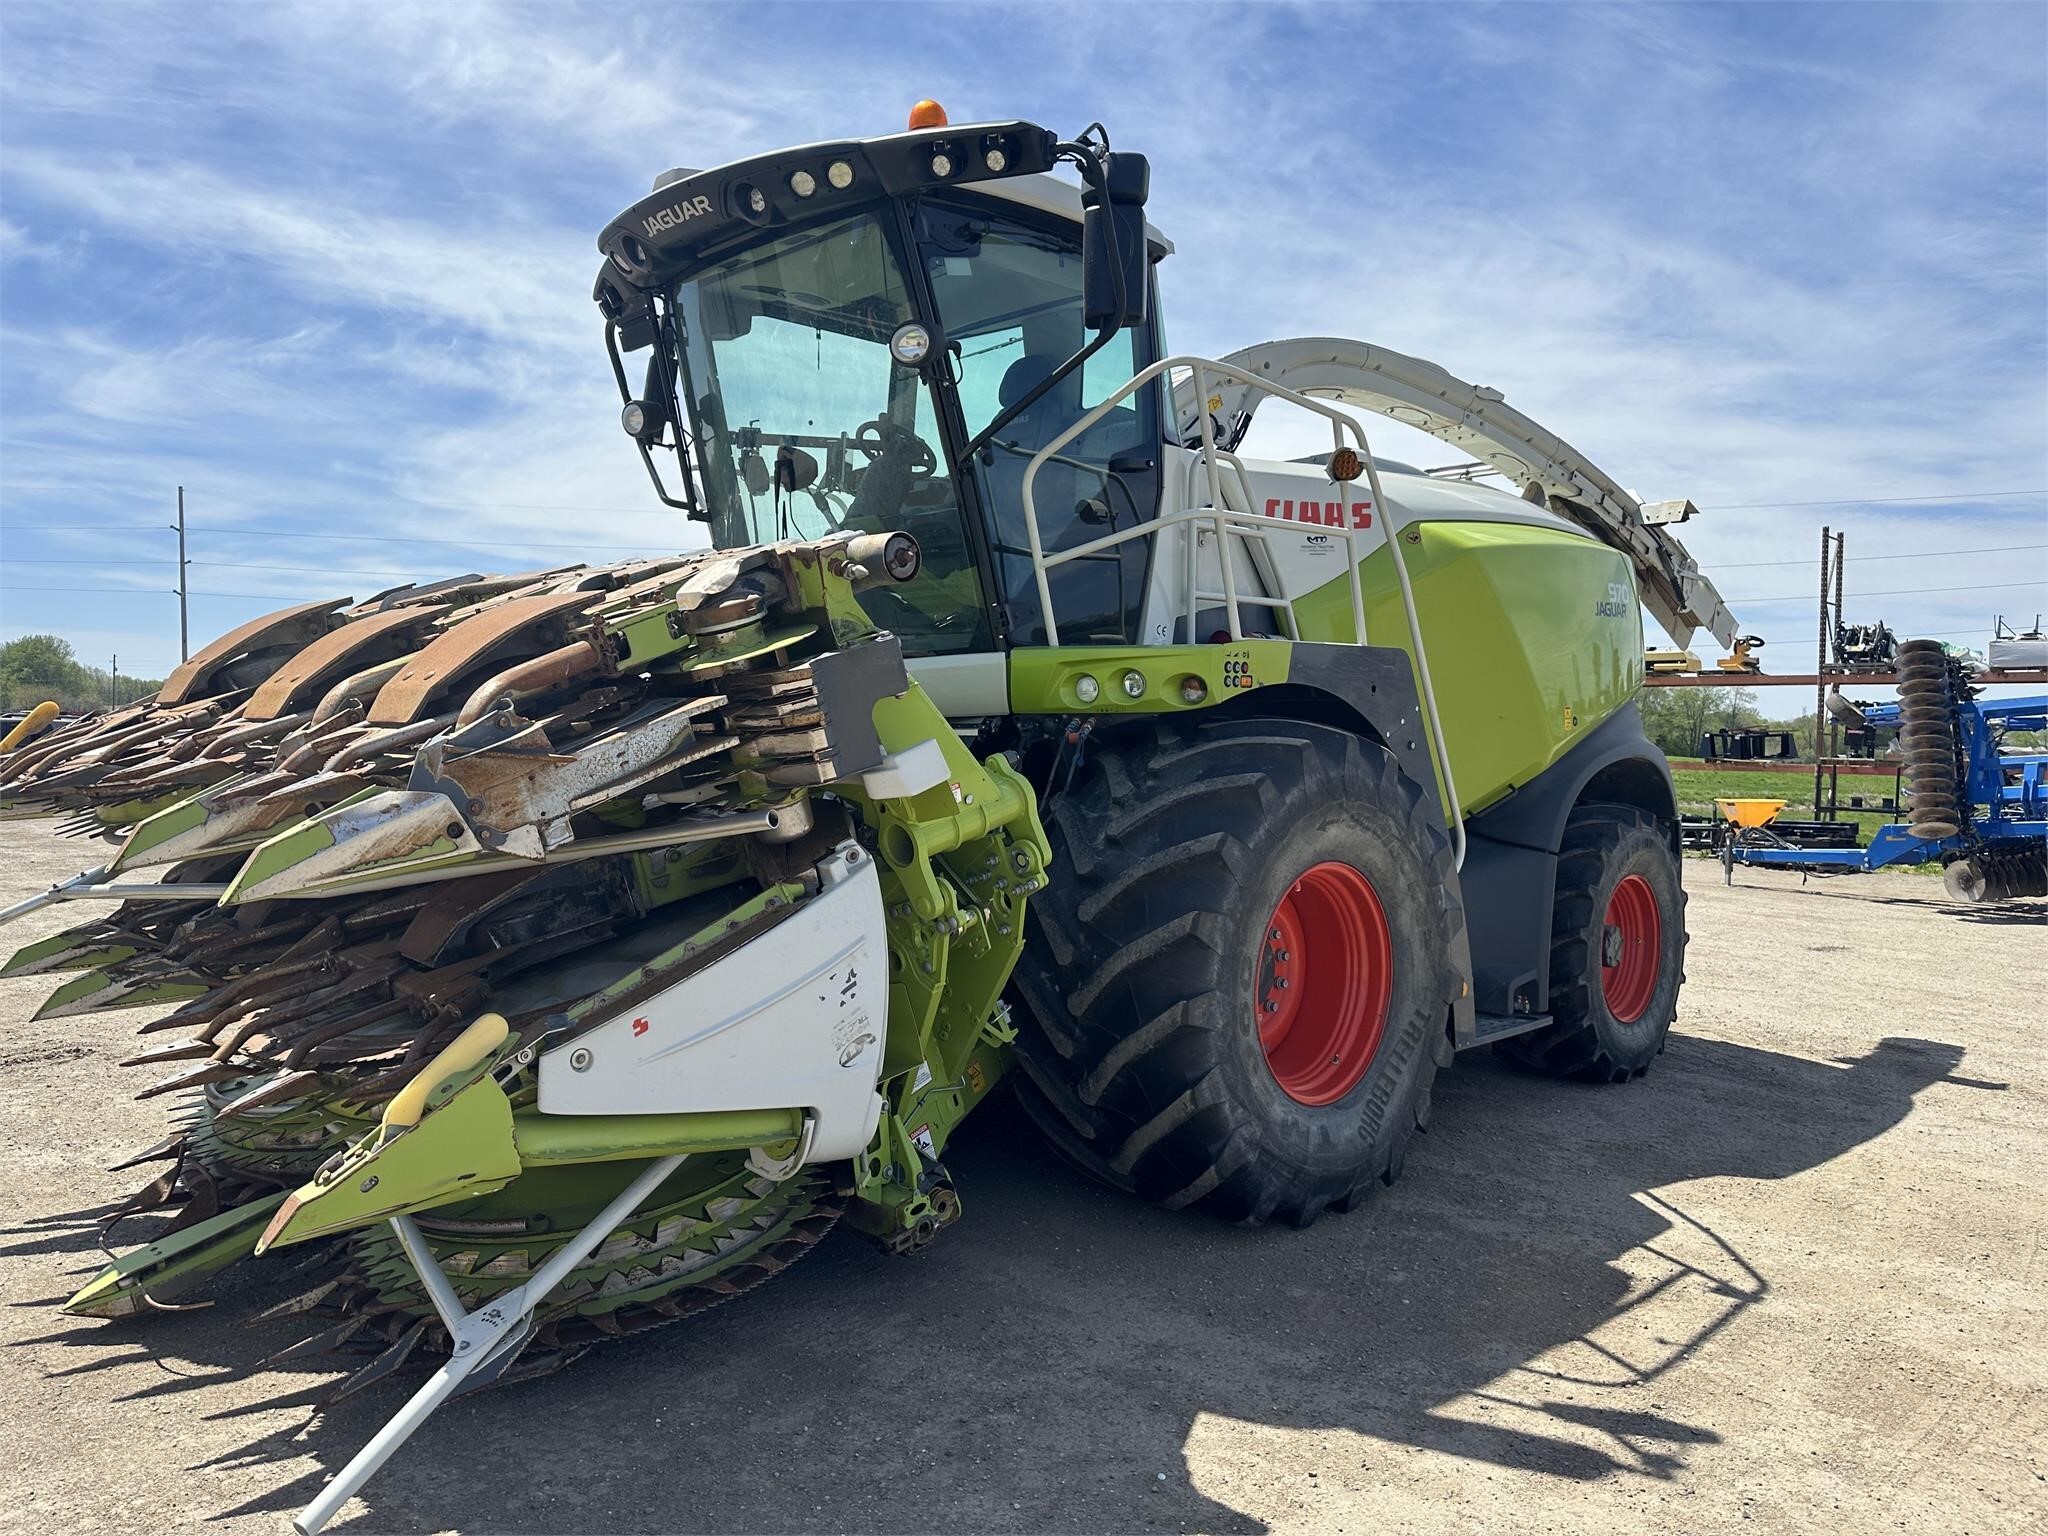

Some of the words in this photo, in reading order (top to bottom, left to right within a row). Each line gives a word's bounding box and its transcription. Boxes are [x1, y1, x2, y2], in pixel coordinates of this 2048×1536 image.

[642, 195, 714, 238] JAGUAR
[1594, 600, 1627, 618] JAGUAR
[1607, 582, 1629, 604] 970
[1358, 1008, 1432, 1147] TRELLEBORG
